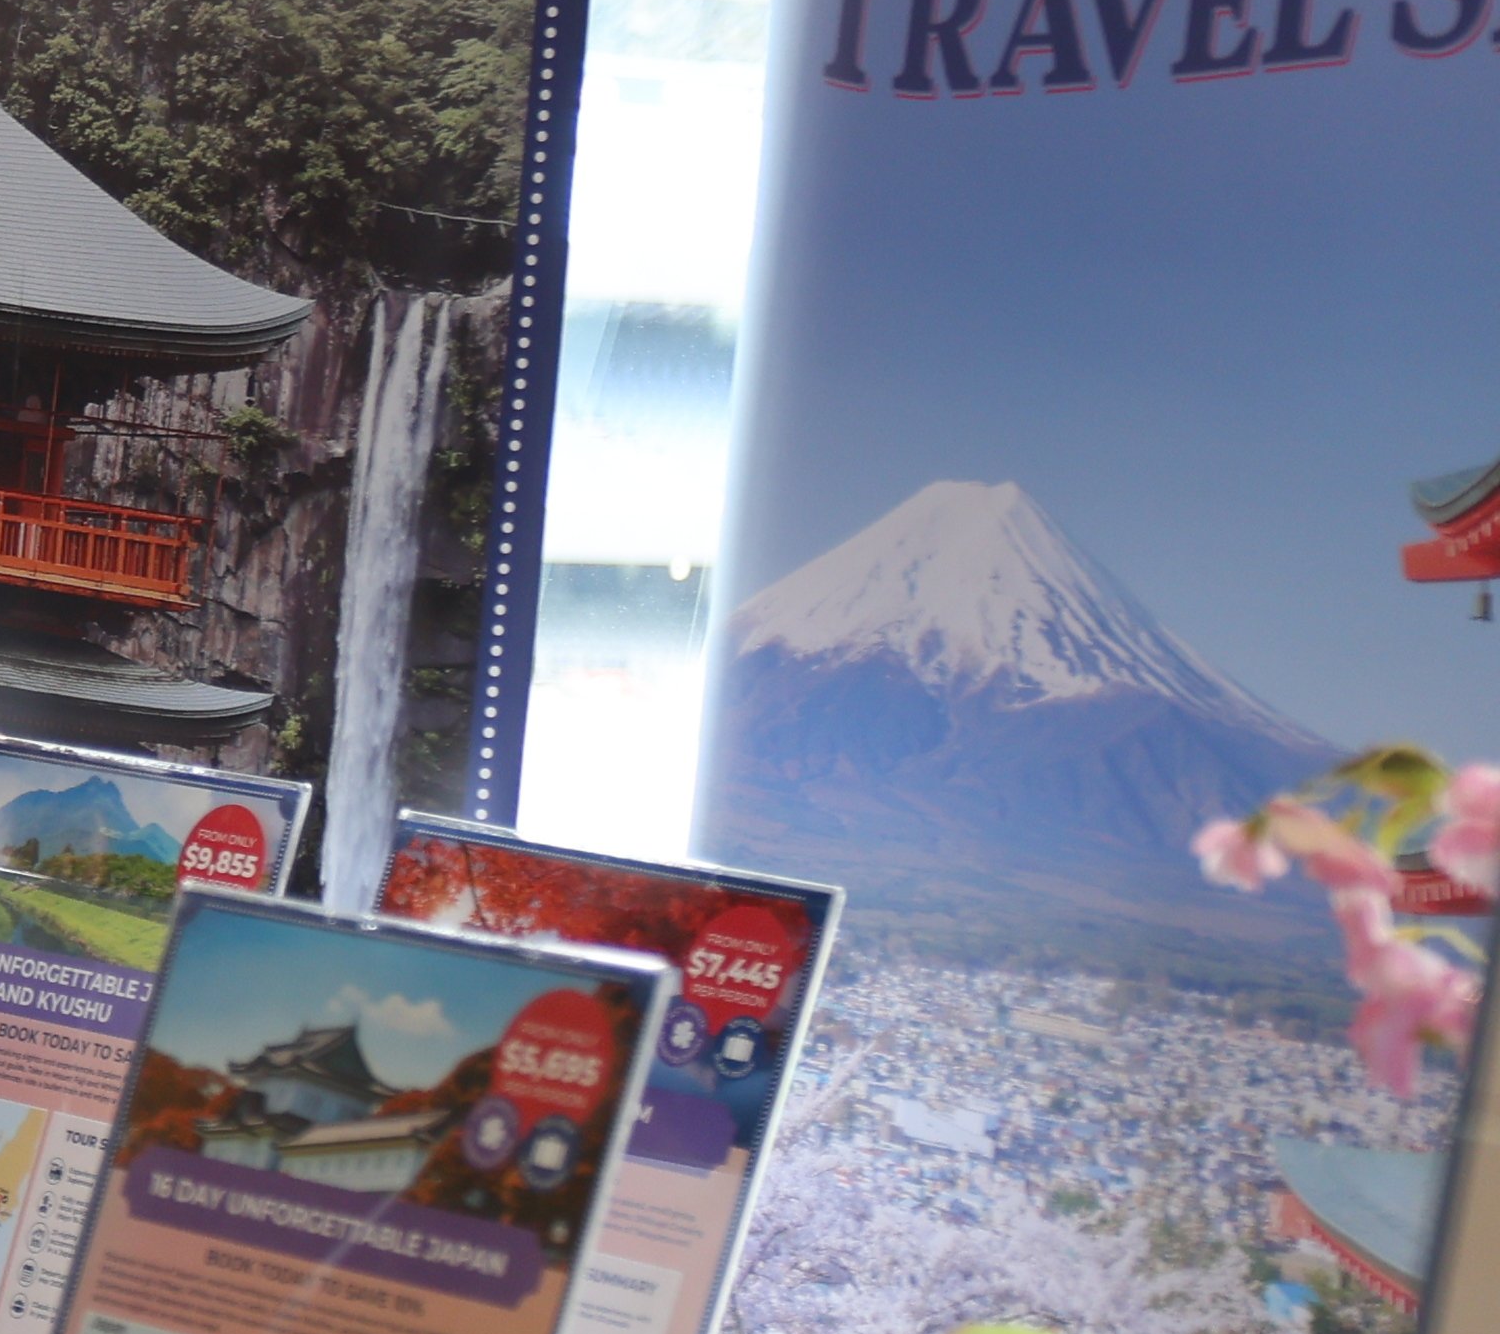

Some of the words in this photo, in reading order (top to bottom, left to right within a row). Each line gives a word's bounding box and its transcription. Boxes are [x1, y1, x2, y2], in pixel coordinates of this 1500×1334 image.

[198, 828, 229, 843] FROM
[230, 833, 258, 848] ONLY
[182, 845, 259, 879] $9,855
[706, 932, 743, 950] FROM
[744, 938, 780, 955] ONLY
[687, 946, 784, 990] $7,445
[36, 989, 113, 1024] KYUSHU
[720, 988, 770, 1008] PERSON
[41, 1031, 91, 1055] TODAY
[93, 1042, 112, 1060] TO
[113, 1047, 132, 1064] SA
[66, 1129, 98, 1147] TOUR
[149, 1172, 175, 1201] 16
[174, 1179, 225, 1213] DAY
[227, 1189, 424, 1260] UNFORGETTABLE
[425, 1236, 510, 1278] JAPAN
